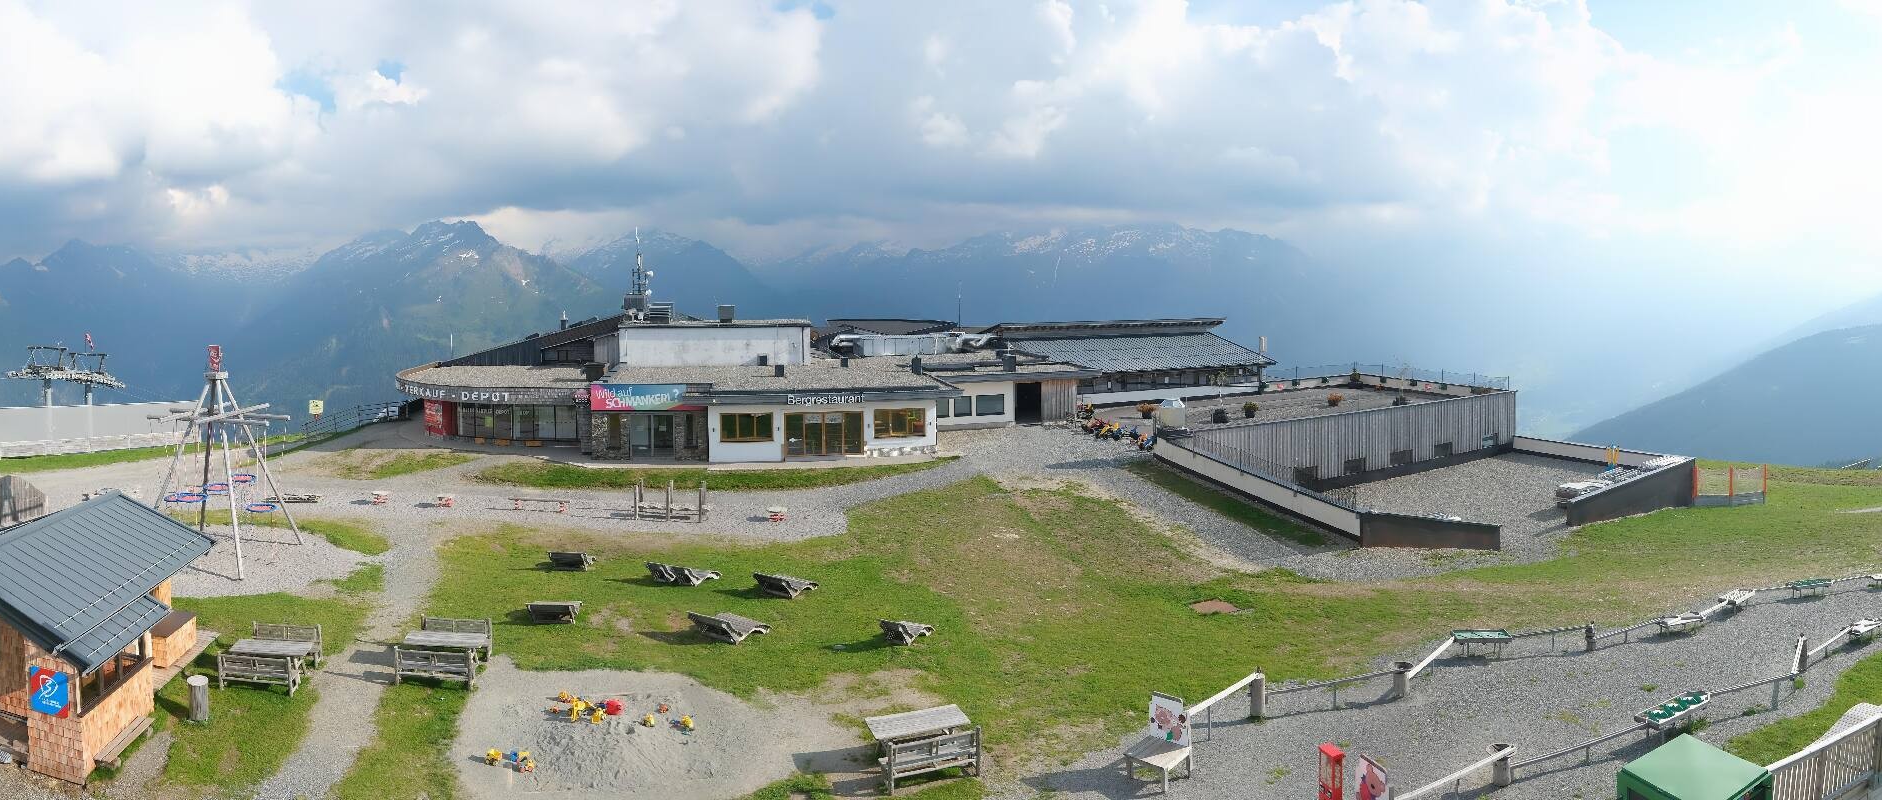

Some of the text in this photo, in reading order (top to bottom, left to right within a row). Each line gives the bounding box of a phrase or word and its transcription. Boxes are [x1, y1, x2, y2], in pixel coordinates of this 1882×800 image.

[404, 384, 447, 399] VERKAUF
[461, 391, 510, 402] DEPOT
[595, 386, 633, 399] Wild auf
[787, 393, 865, 406] Bergrestaurant
